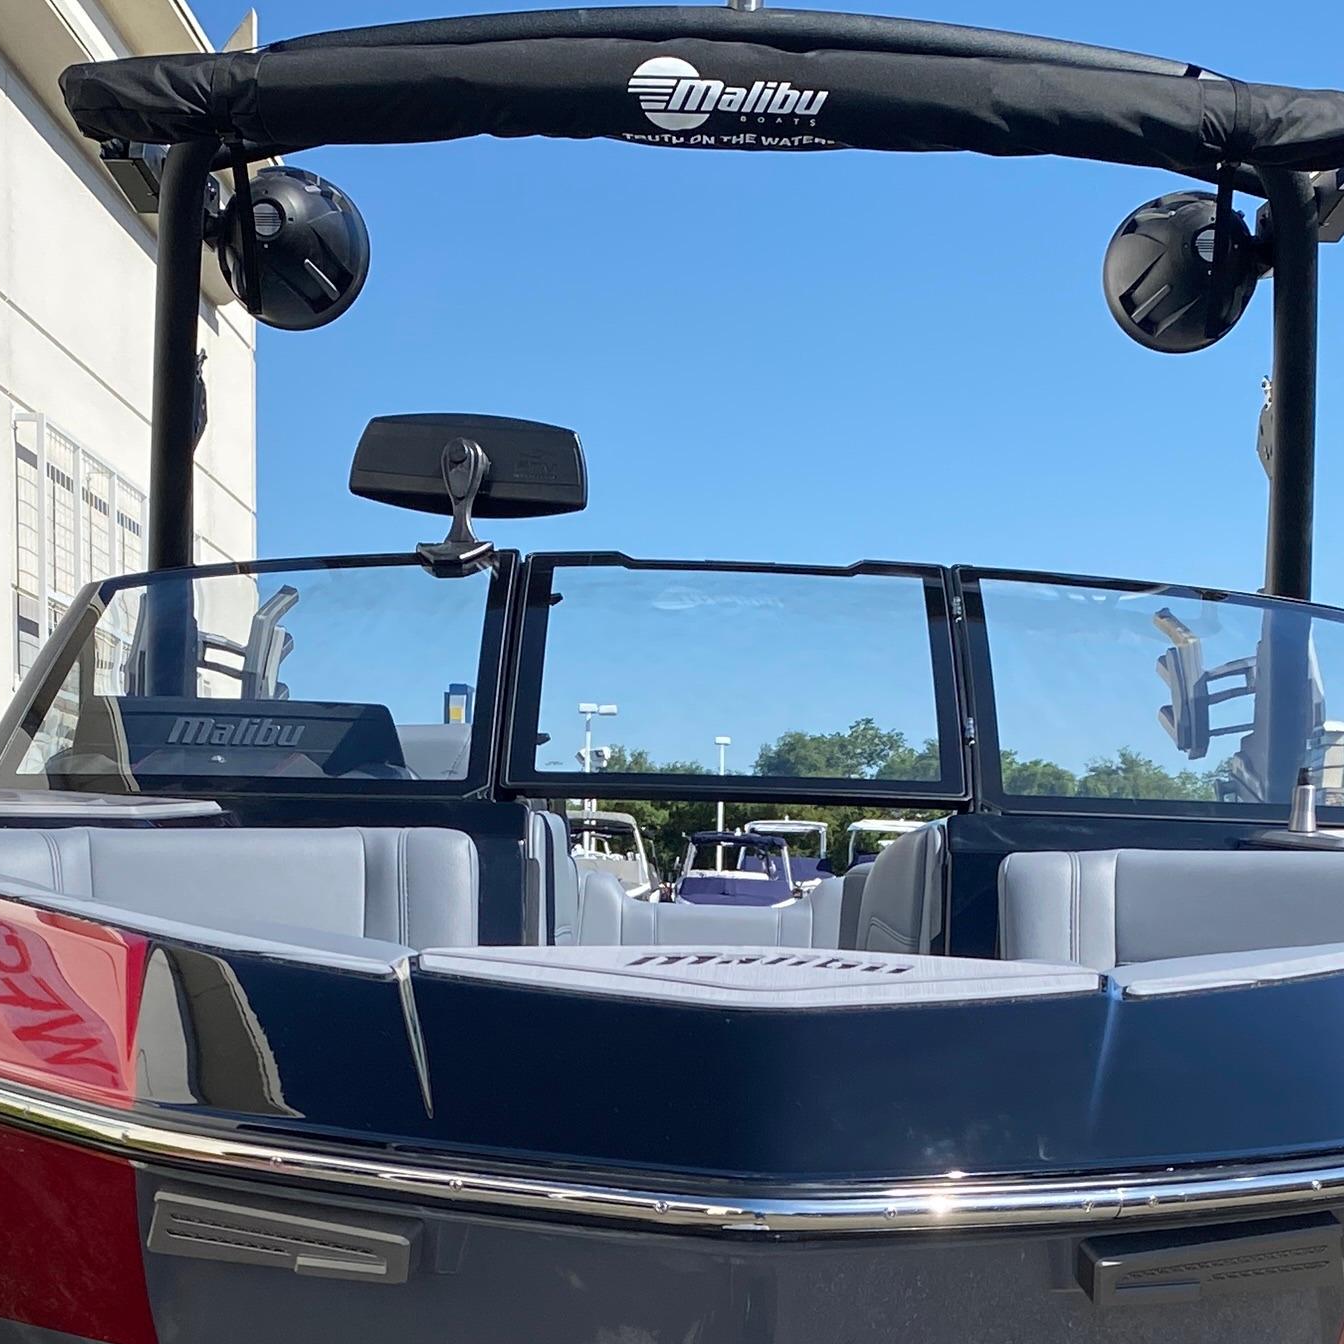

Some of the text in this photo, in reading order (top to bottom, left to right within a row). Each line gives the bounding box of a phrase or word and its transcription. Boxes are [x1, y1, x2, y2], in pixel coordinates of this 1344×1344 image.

[667, 78, 829, 116] Malibu
[739, 115, 817, 127] BOATS
[689, 134, 716, 146] ON
[720, 132, 757, 145] THE
[166, 715, 306, 747] Malibu
